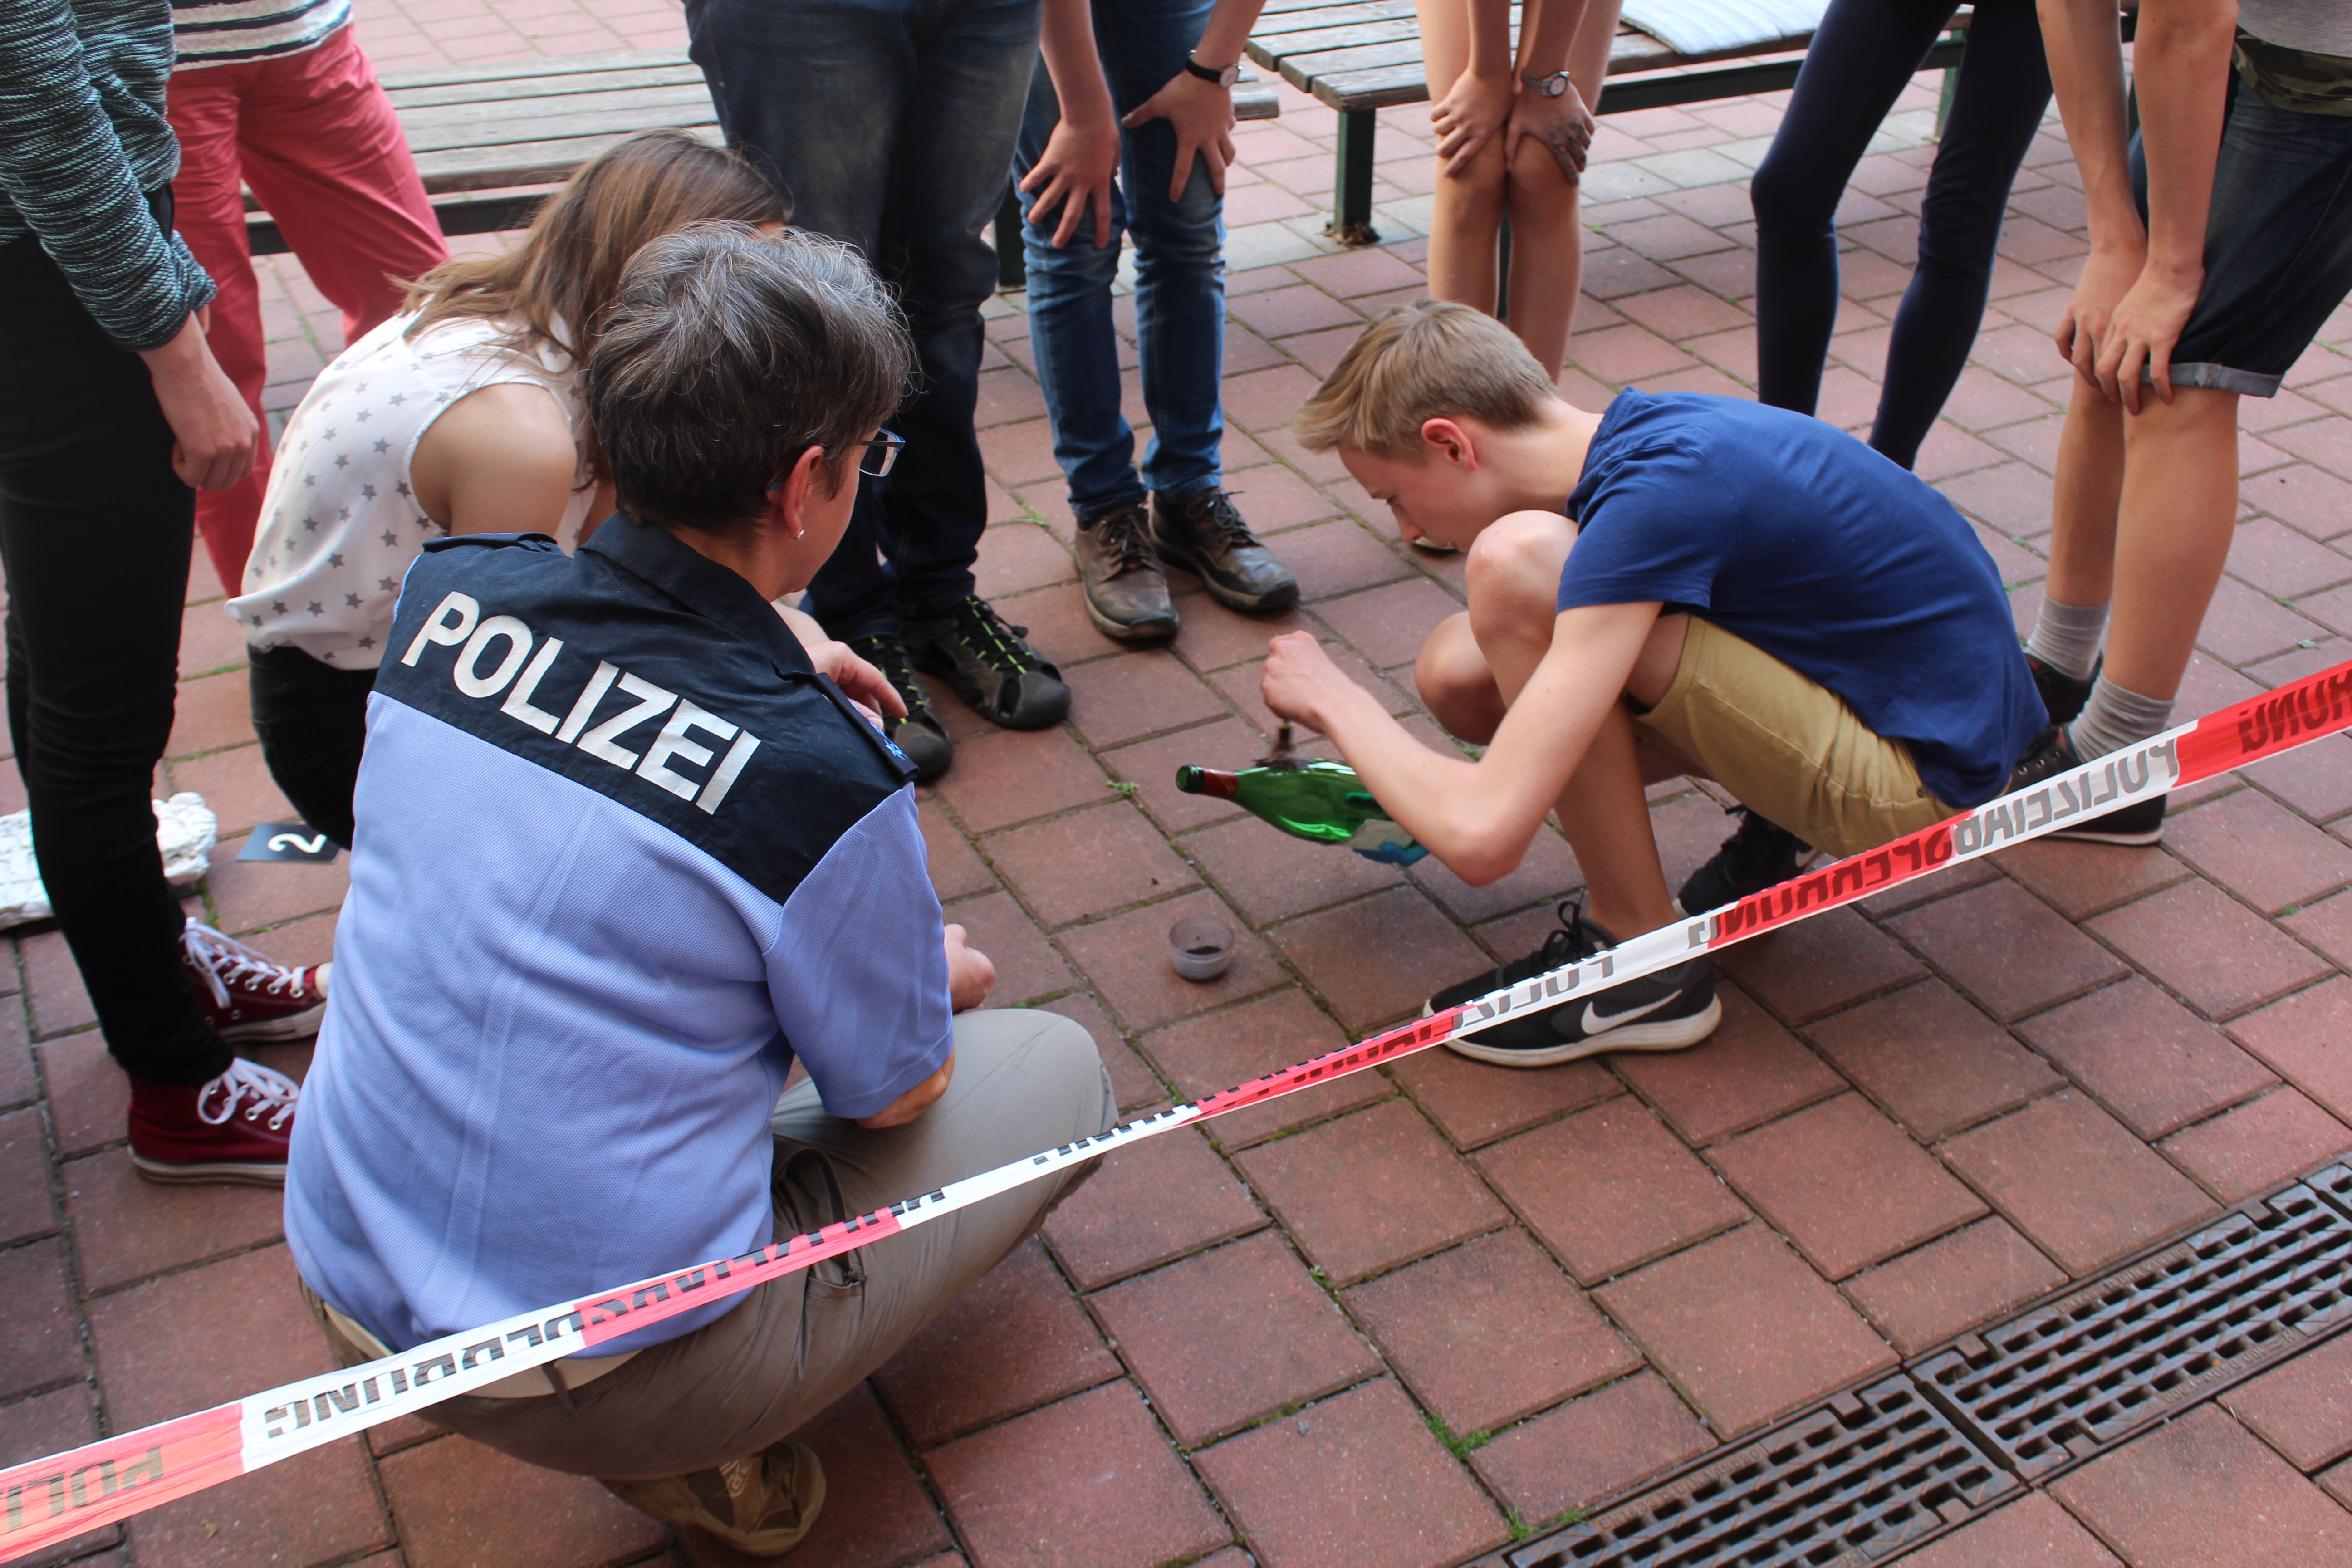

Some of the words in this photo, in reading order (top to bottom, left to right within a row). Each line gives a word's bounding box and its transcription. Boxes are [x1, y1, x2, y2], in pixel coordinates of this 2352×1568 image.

[401, 591, 761, 815] POLIZEI
[267, 833, 328, 854] 2
[0, 1444, 164, 1532] POLI
